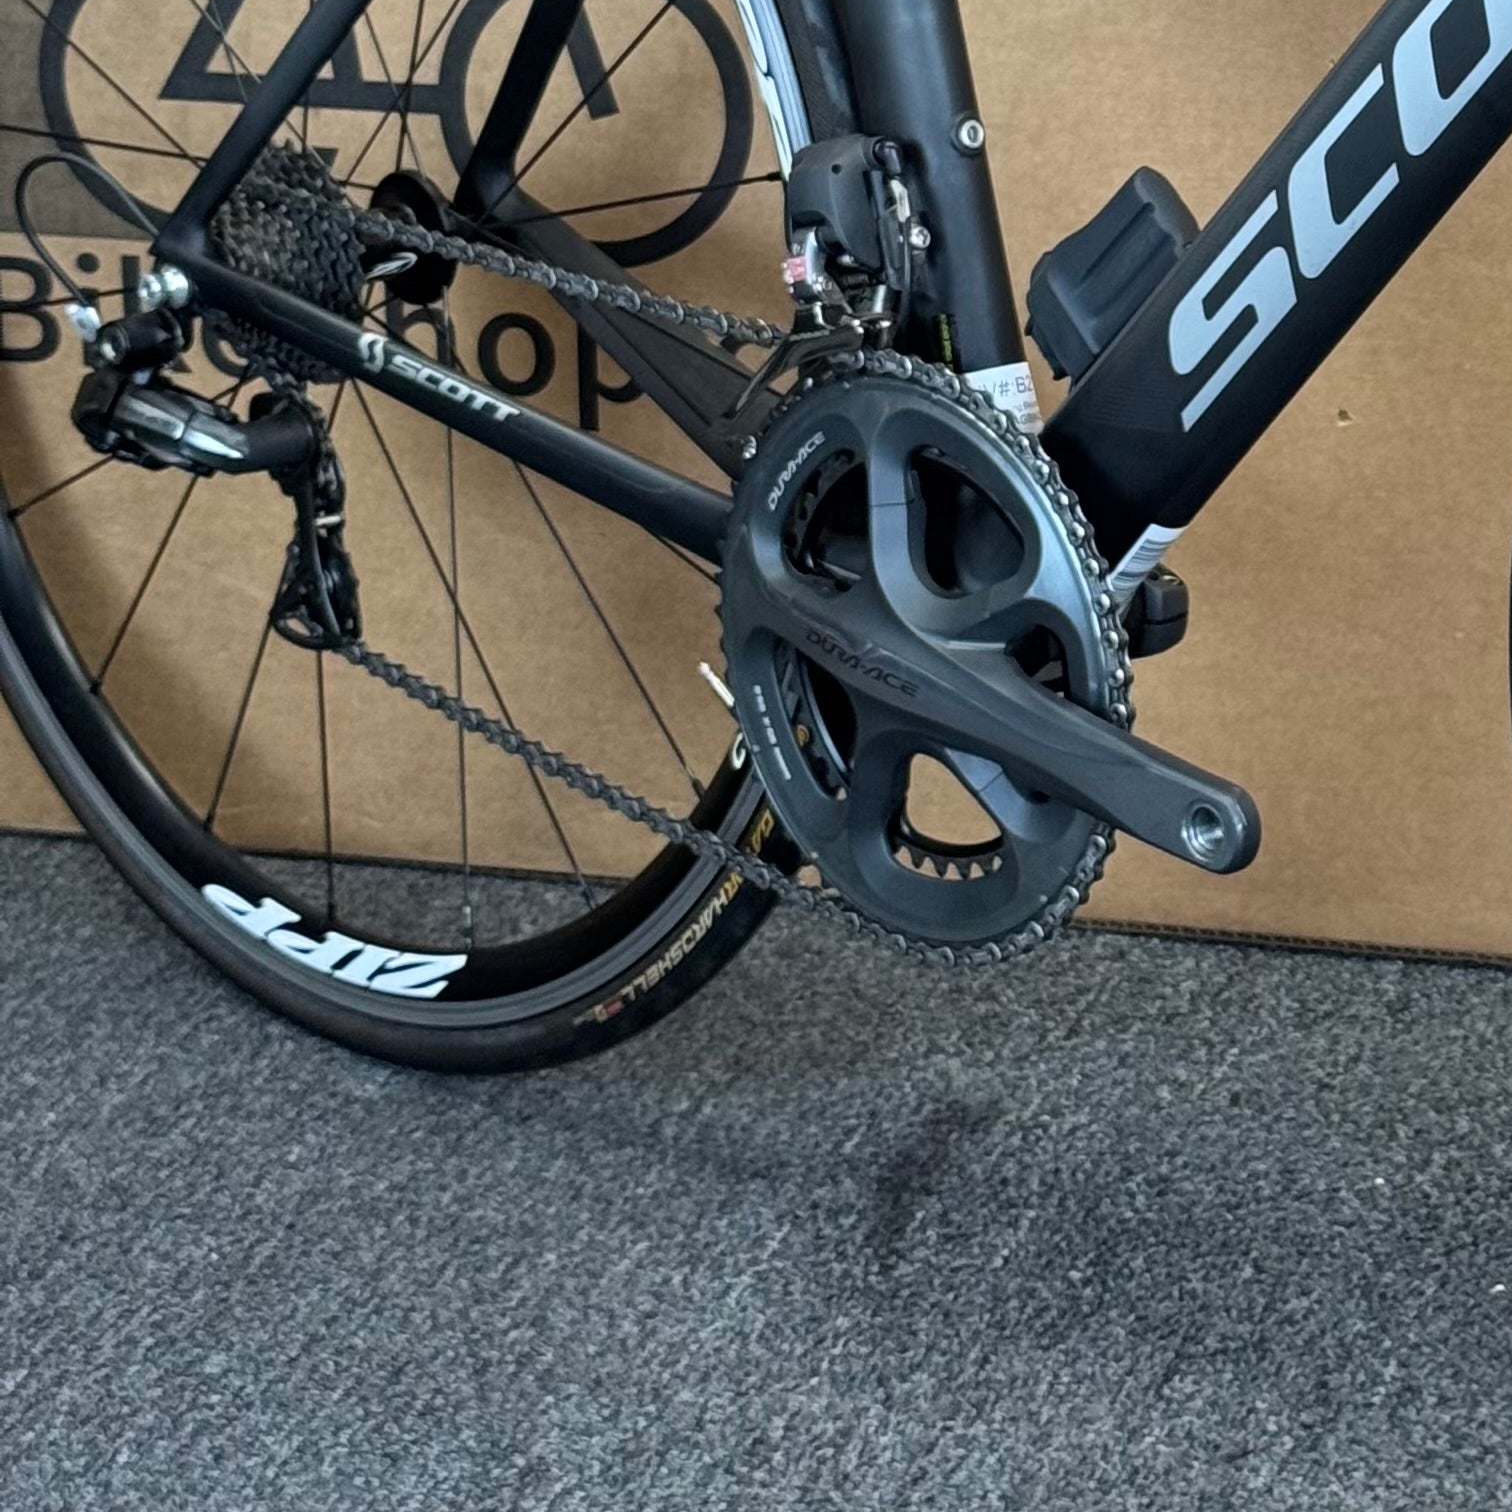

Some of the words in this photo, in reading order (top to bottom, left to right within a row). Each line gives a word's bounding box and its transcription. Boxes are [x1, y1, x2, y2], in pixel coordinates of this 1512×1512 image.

[389, 353, 521, 422] SCOTT
[768, 431, 826, 512] DURA-ACE
[805, 630, 920, 699] DURA-ACE
[201, 883, 469, 999] ZIPP
